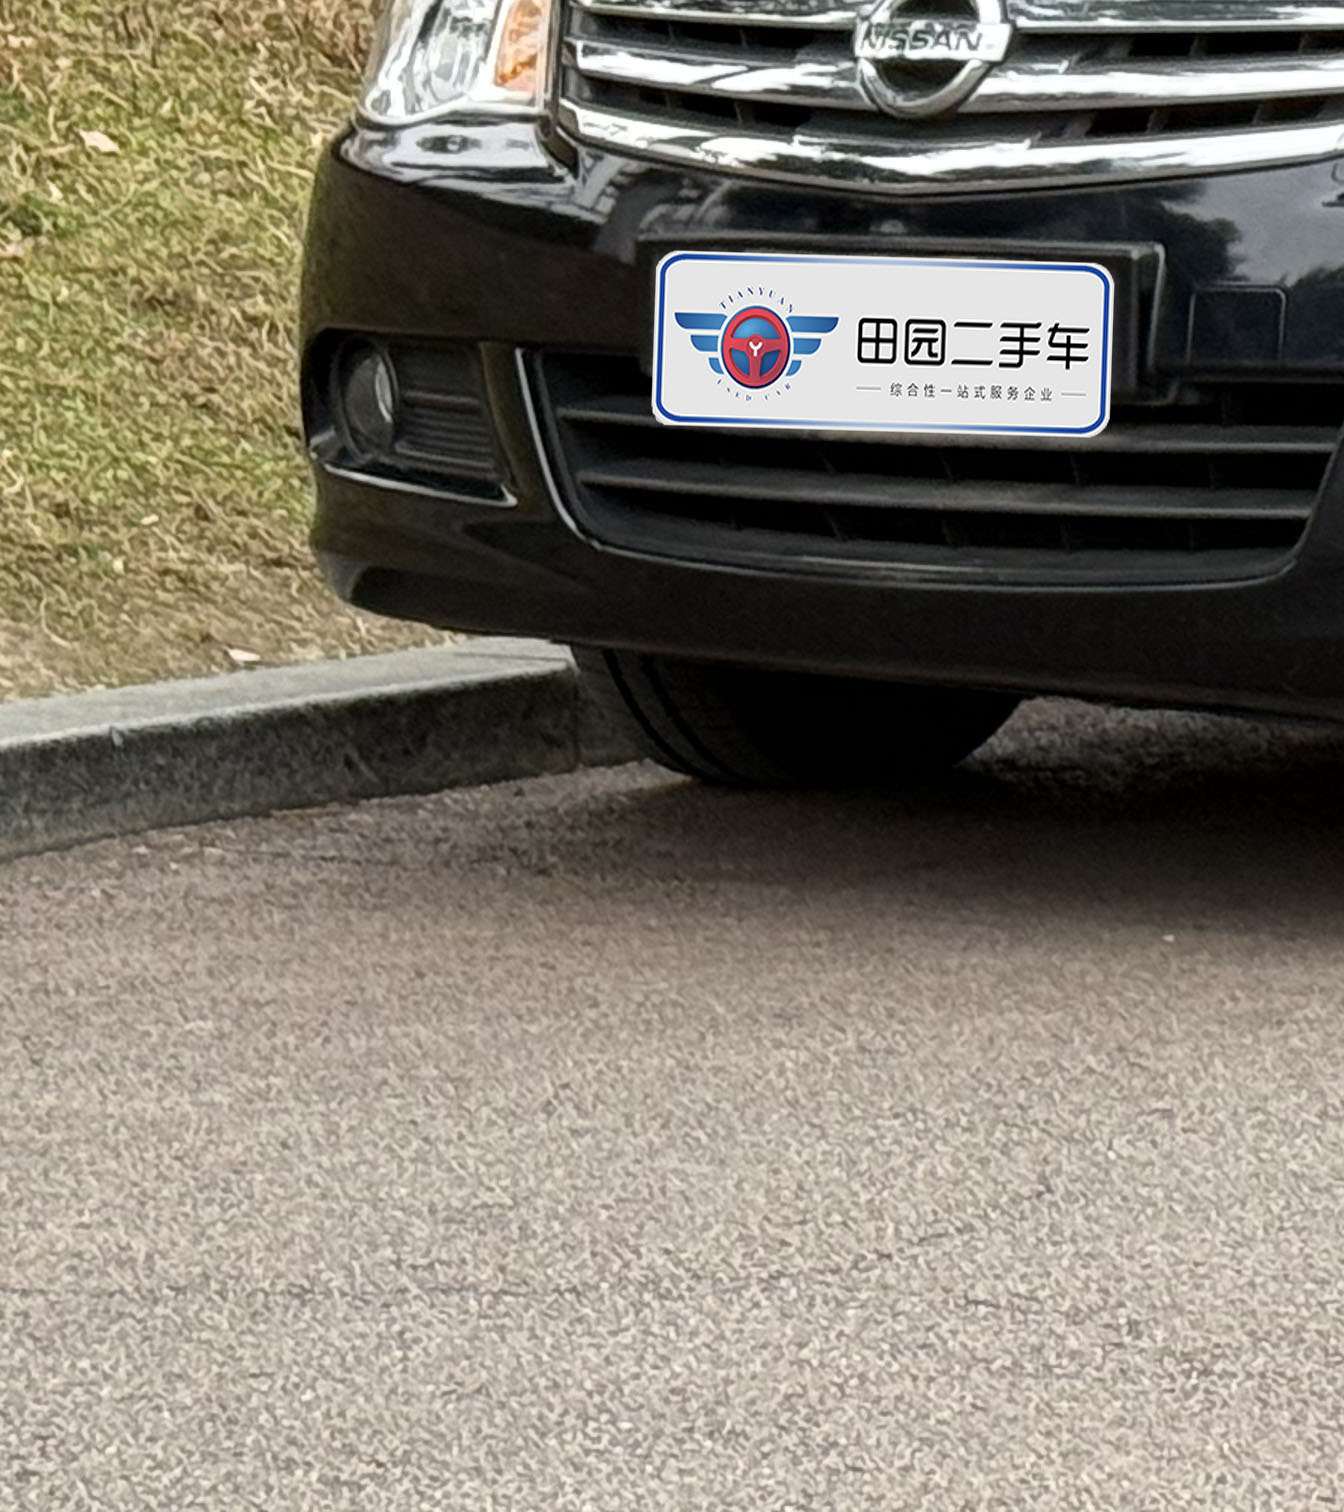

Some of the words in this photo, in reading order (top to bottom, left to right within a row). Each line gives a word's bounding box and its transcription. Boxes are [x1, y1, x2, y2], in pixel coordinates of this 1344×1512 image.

[861, 25, 983, 51] NISSAN
[857, 317, 1090, 370] 田园二手车
[890, 381, 1053, 402] 综合性一站式服务企业
